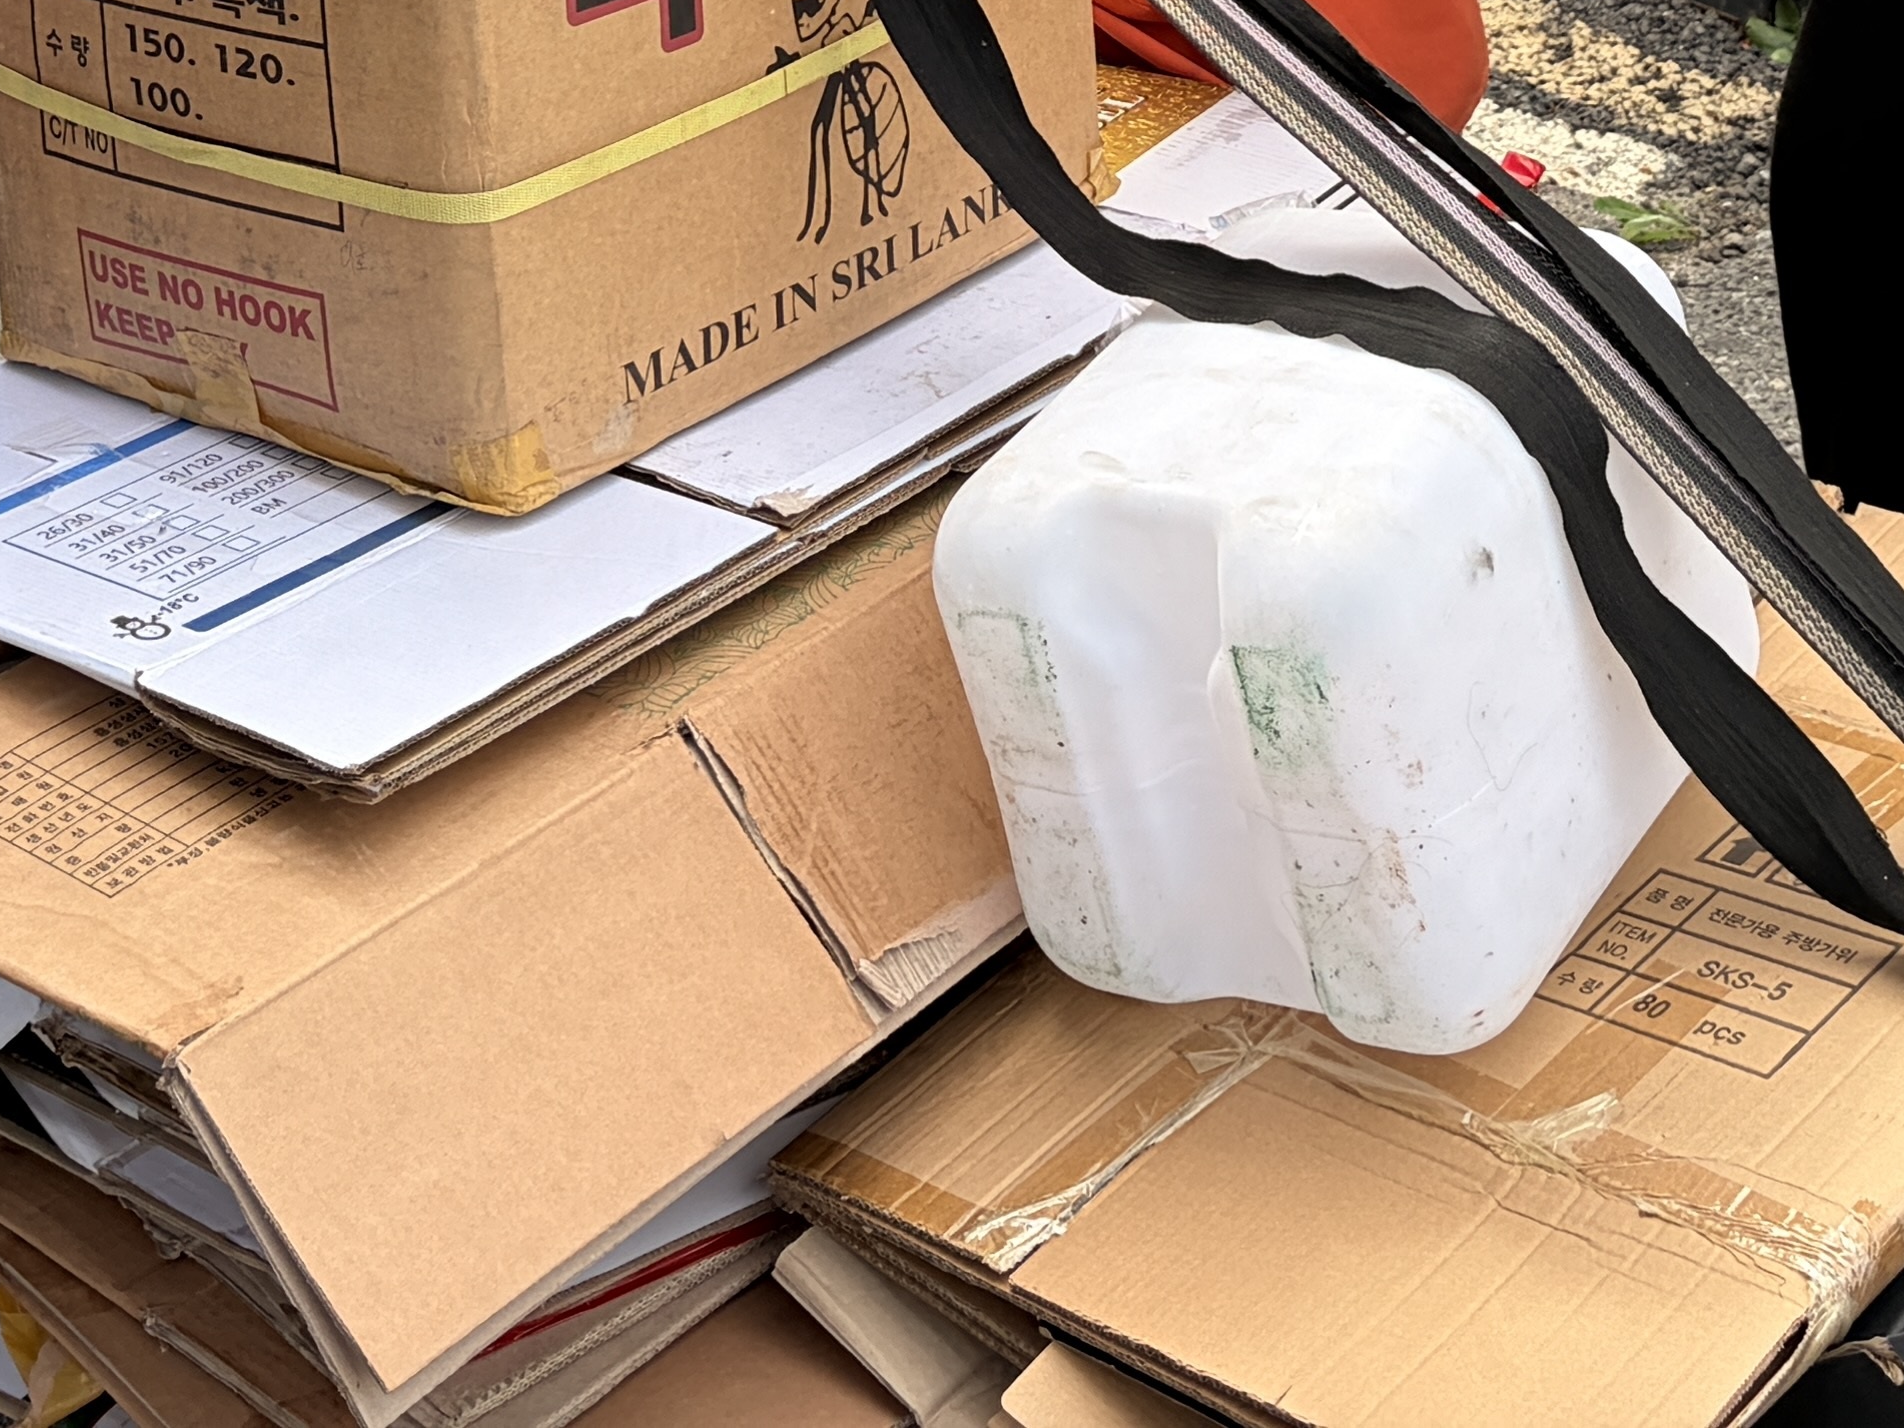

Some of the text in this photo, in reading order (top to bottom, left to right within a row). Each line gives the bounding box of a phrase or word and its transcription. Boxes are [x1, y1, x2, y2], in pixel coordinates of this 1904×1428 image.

[124, 22, 197, 67] 150.
[214, 42, 296, 87] 120.
[129, 76, 204, 121] 100.
[87, 249, 317, 343] USE NO HOOK
[94, 299, 176, 346] KEEP
[620, 182, 1015, 407] MADE IN SRI LANK
[67, 458, 266, 554] 31/40 100/200
[98, 468, 296, 564] 31/50 200/300
[128, 495, 288, 574] 51/70 BM
[158, 554, 218, 585] 71/90
[1595, 940, 1628, 961] NO.
[1607, 919, 1794, 1002] ITEM SKS-5
[1707, 905, 1779, 940] 전문가용
[1781, 929, 1860, 966] 주방가위
[1632, 992, 1672, 1020] 80
[1691, 1017, 1747, 1047] pcs
